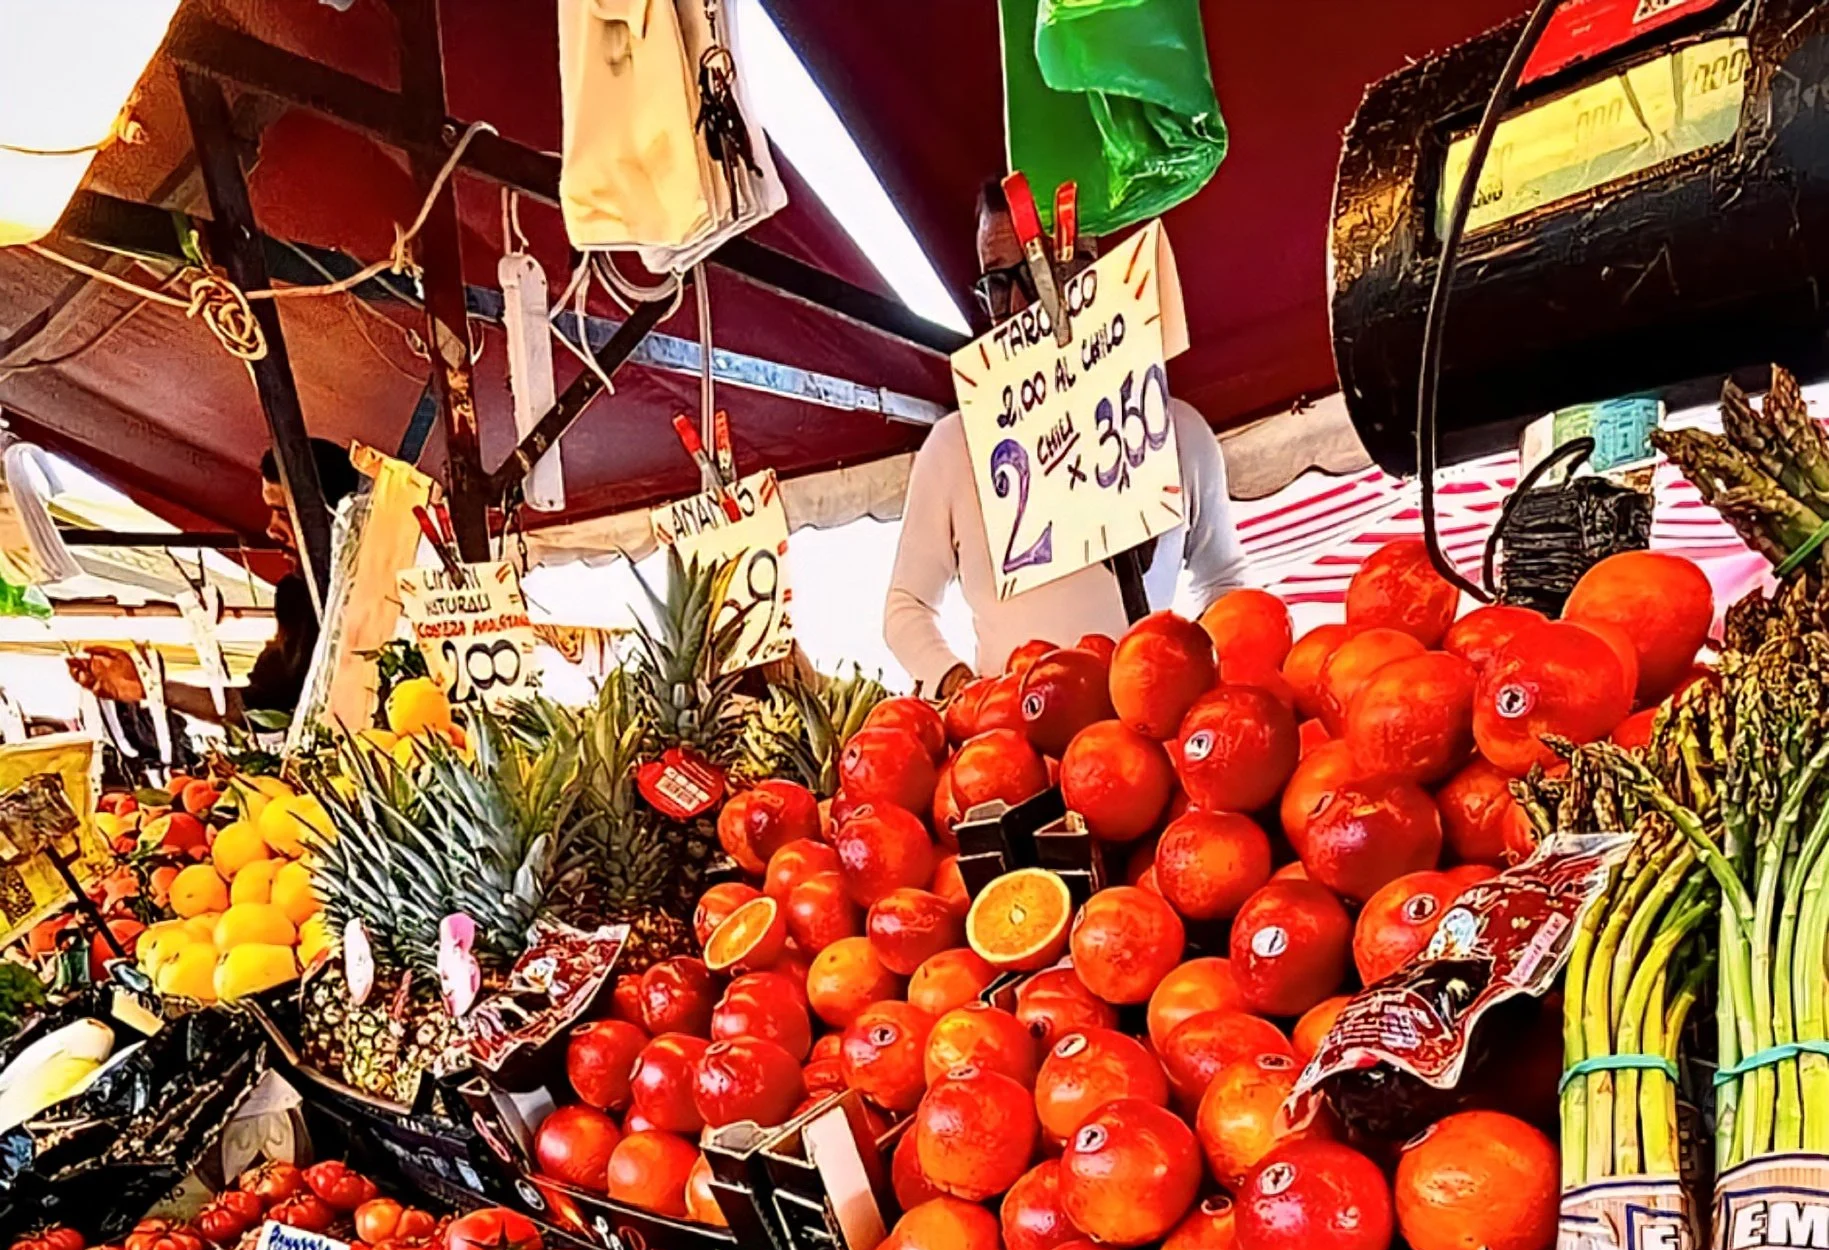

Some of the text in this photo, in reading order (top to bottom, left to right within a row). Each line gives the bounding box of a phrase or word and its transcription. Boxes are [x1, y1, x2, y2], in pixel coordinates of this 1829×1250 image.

[993, 269, 1098, 361] TAROCO
[1054, 356, 1077, 394] AL
[672, 486, 755, 541] ANANS
[990, 439, 1053, 574] 2
